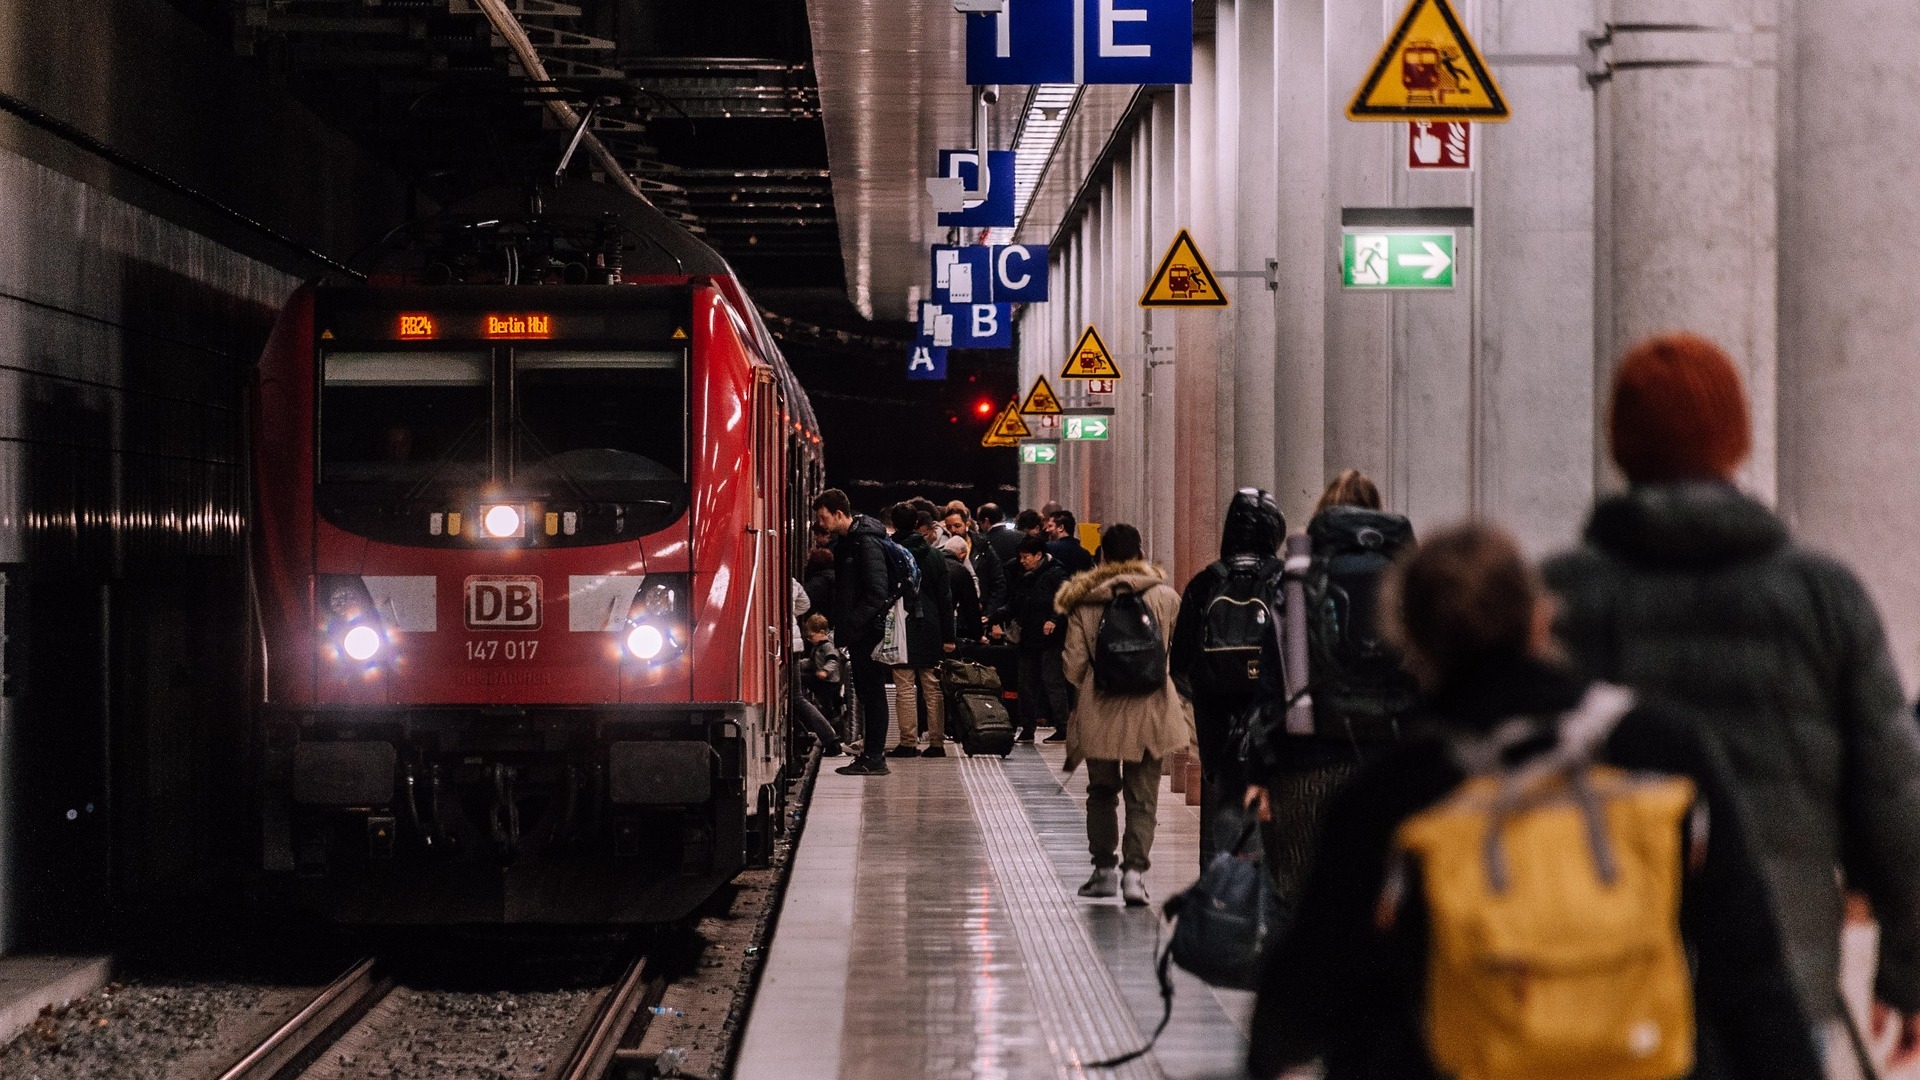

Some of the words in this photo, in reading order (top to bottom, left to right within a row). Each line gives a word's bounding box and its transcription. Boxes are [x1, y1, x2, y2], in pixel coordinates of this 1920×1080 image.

[1099, 0, 1151, 58] E
[949, 153, 991, 209] D
[997, 244, 1031, 290] C
[400, 316, 432, 335] RB24
[489, 316, 525, 334] Berlin
[972, 303, 998, 338] B
[909, 346, 935, 371] A
[475, 585, 533, 622] DB
[465, 640, 499, 660] 147
[504, 640, 539, 660] 017
